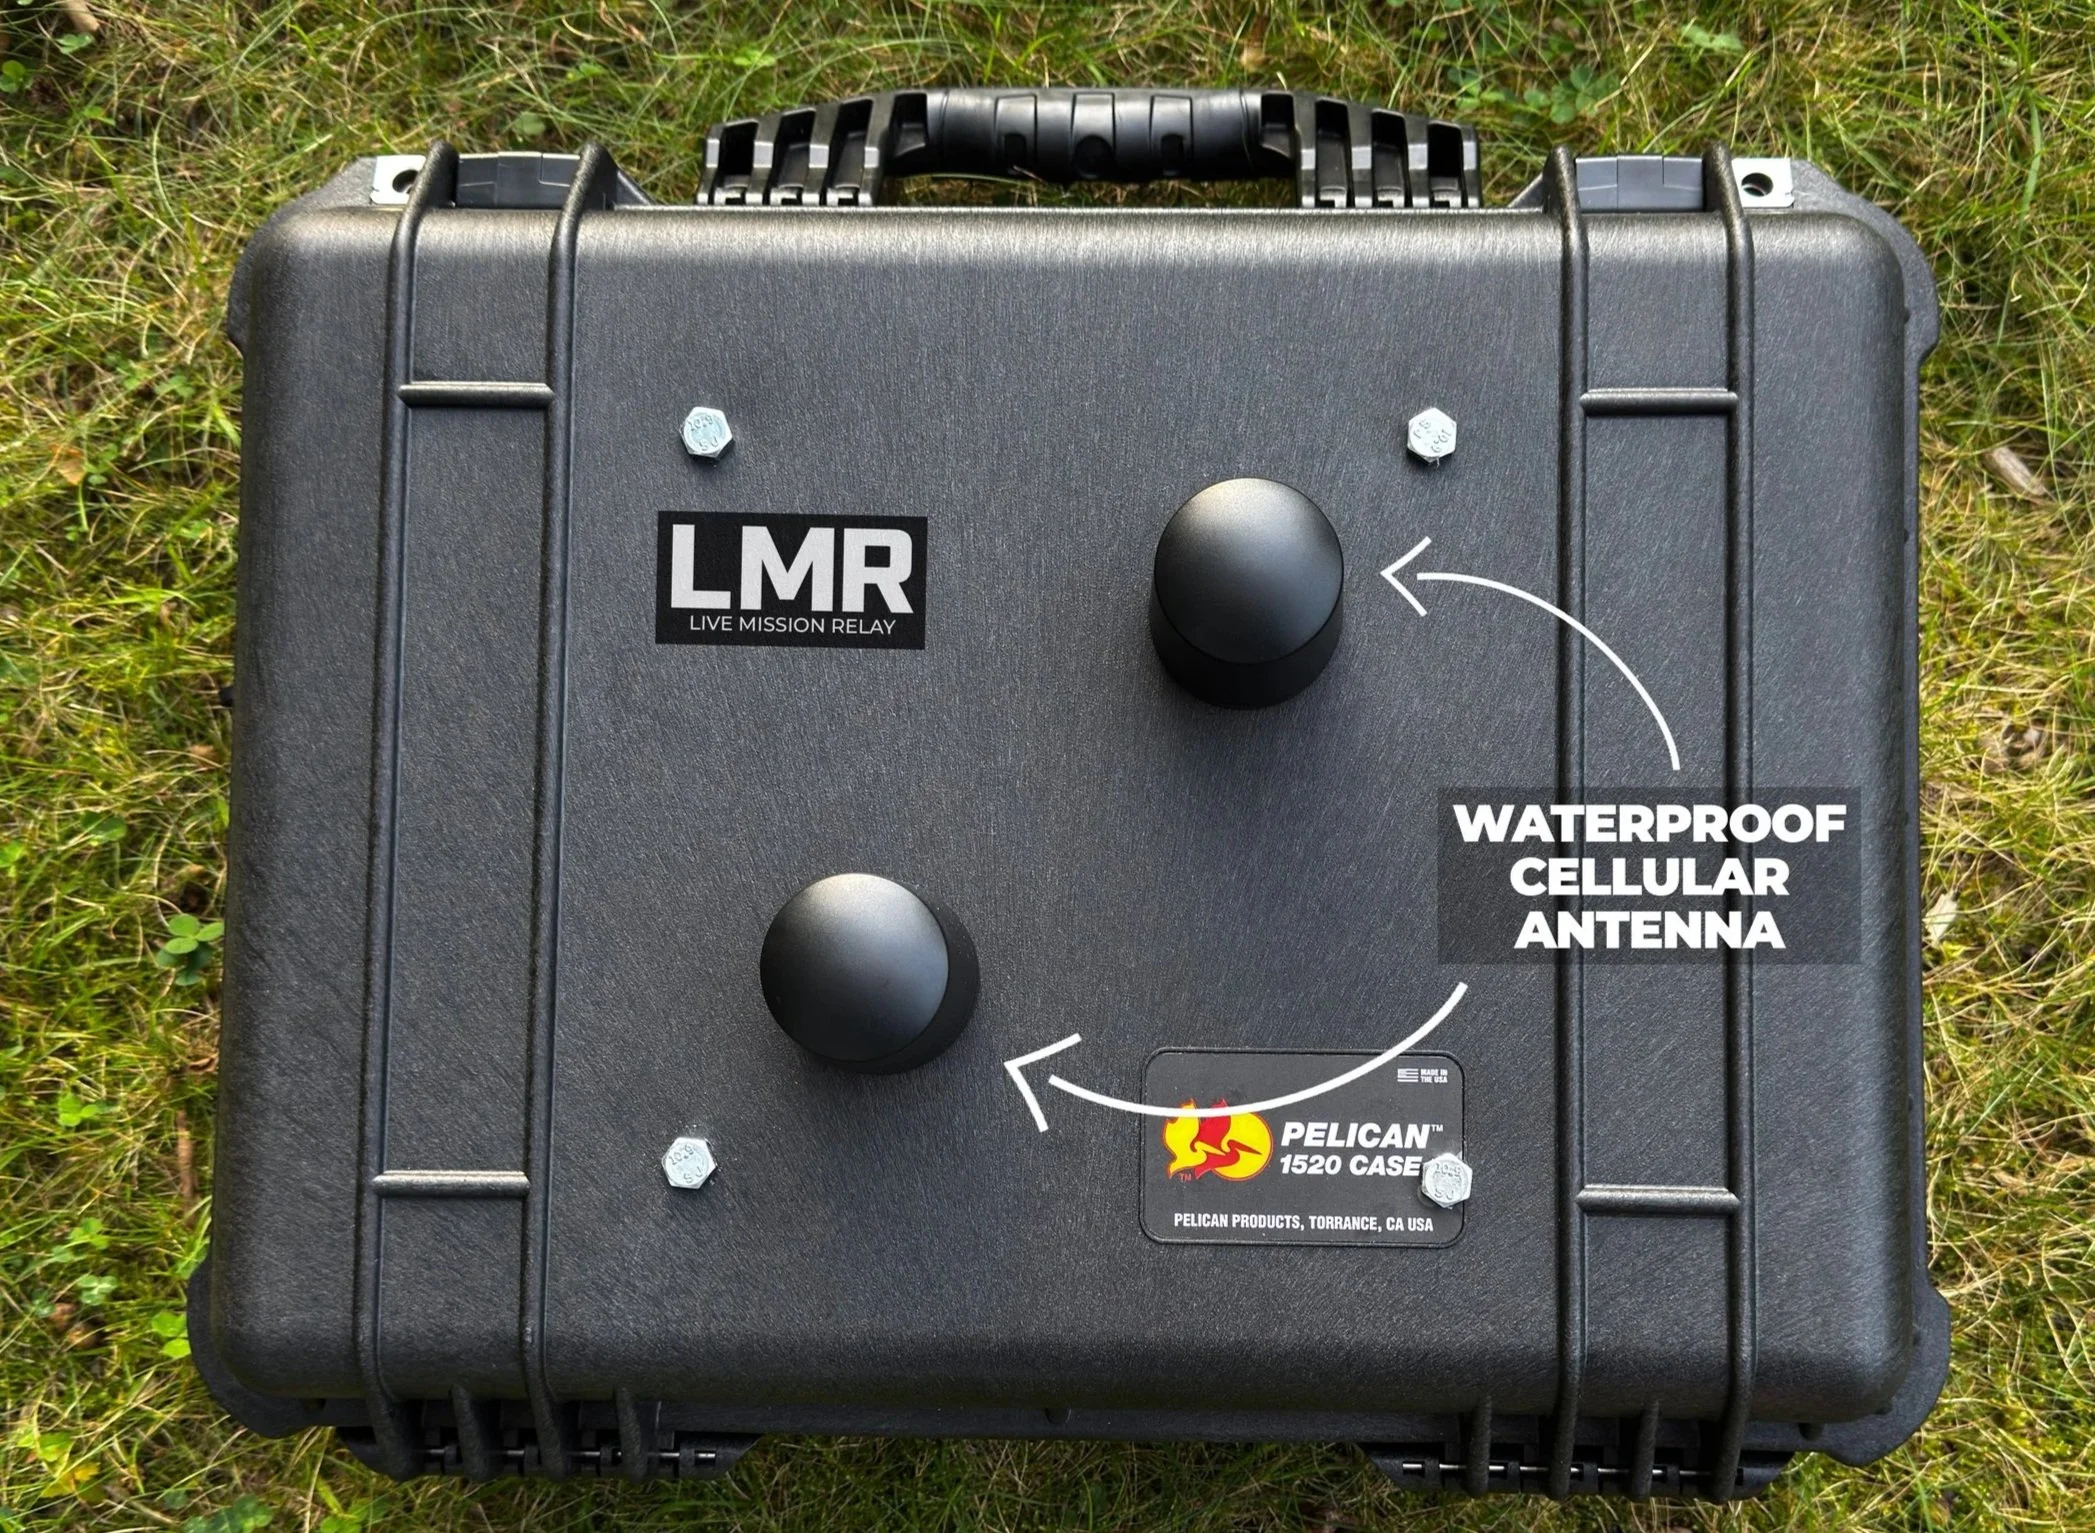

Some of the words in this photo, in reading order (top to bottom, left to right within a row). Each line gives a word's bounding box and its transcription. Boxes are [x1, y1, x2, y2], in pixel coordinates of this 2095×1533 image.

[671, 523, 915, 614] LMR
[689, 615, 733, 632] LIVE
[739, 616, 825, 634] MISSION
[831, 618, 897, 635] RELAY
[1420, 1068, 1439, 1076] MADE
[1440, 1068, 1448, 1076] IN
[1280, 1154, 1342, 1176] 1520
[1349, 1155, 1424, 1177] CASE
[1174, 1212, 1228, 1229] PELICAN
[1232, 1213, 1306, 1232] PRODUCTS,
[1309, 1215, 1382, 1233] TORRANCE,
[1386, 1216, 1404, 1232] CA
[1407, 1217, 1434, 1232] USA
